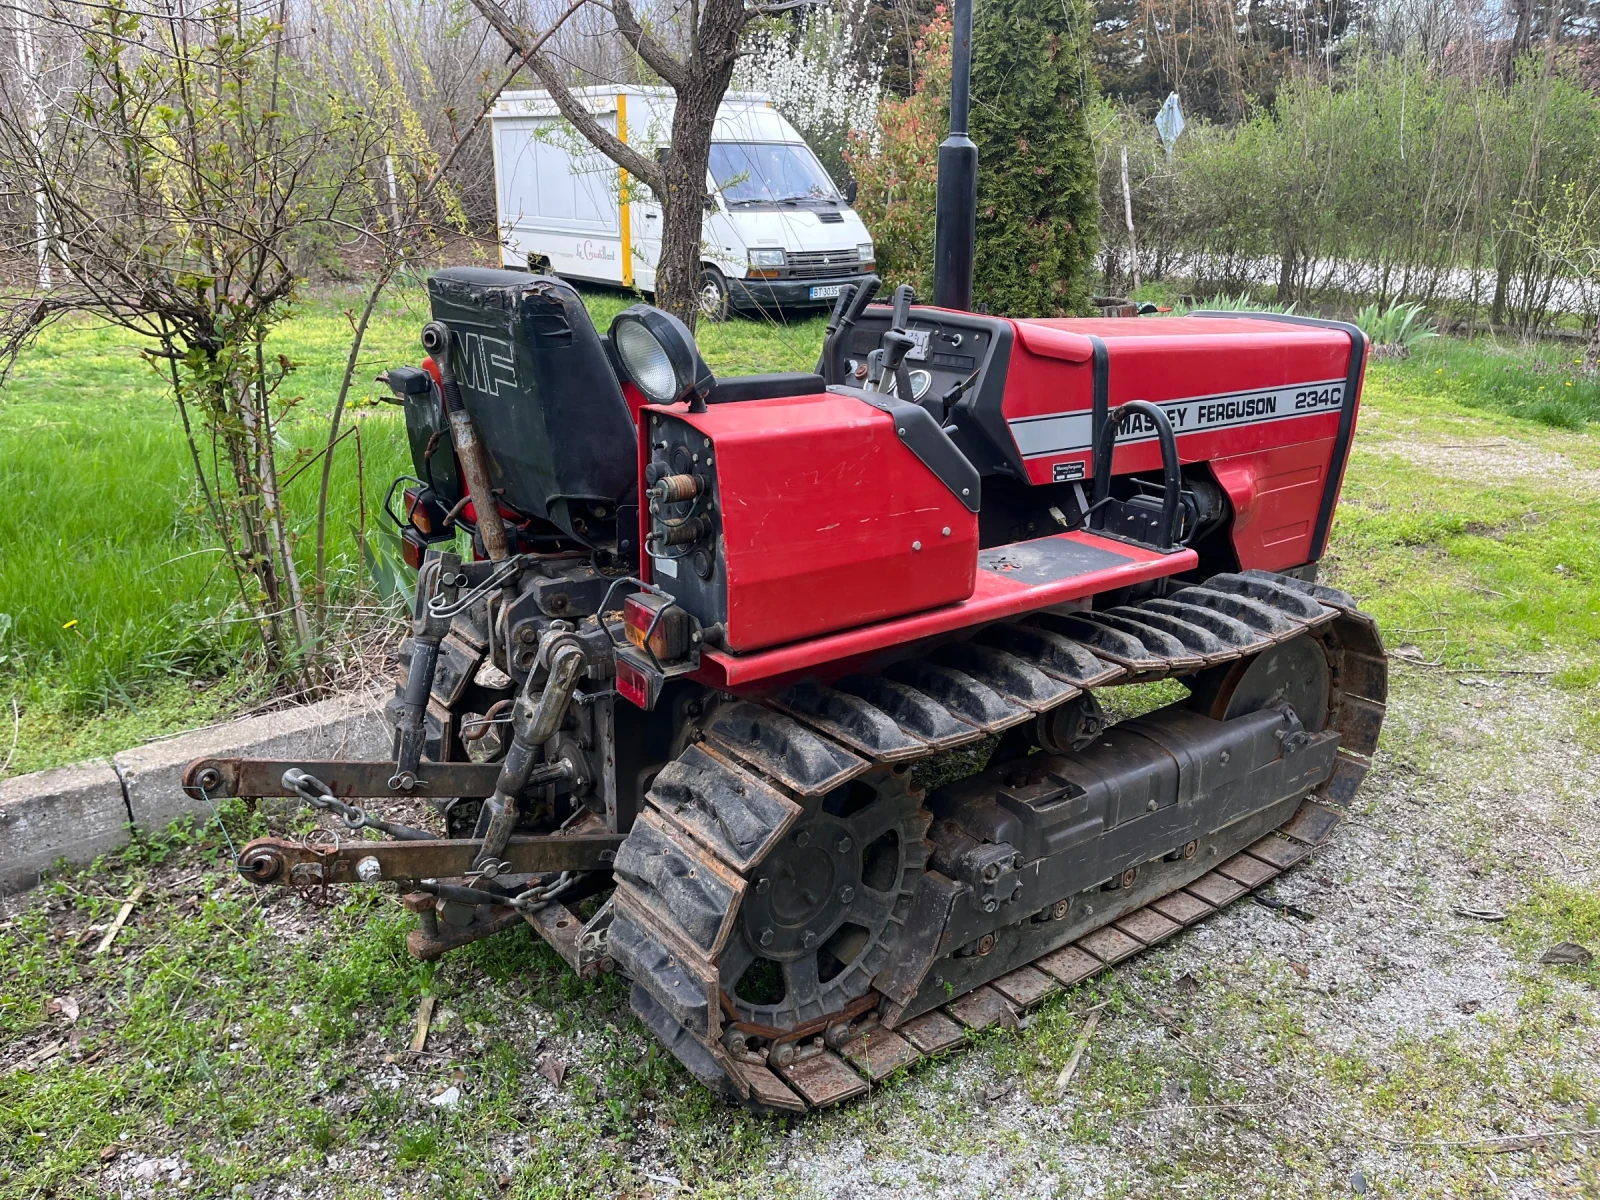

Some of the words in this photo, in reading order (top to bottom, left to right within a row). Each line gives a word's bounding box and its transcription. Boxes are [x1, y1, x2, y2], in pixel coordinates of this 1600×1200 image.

[451, 330, 518, 397] MF
[1115, 407, 1188, 437] MASEY
[1197, 396, 1278, 424] FERGUSON
[1295, 387, 1342, 410] 234C
